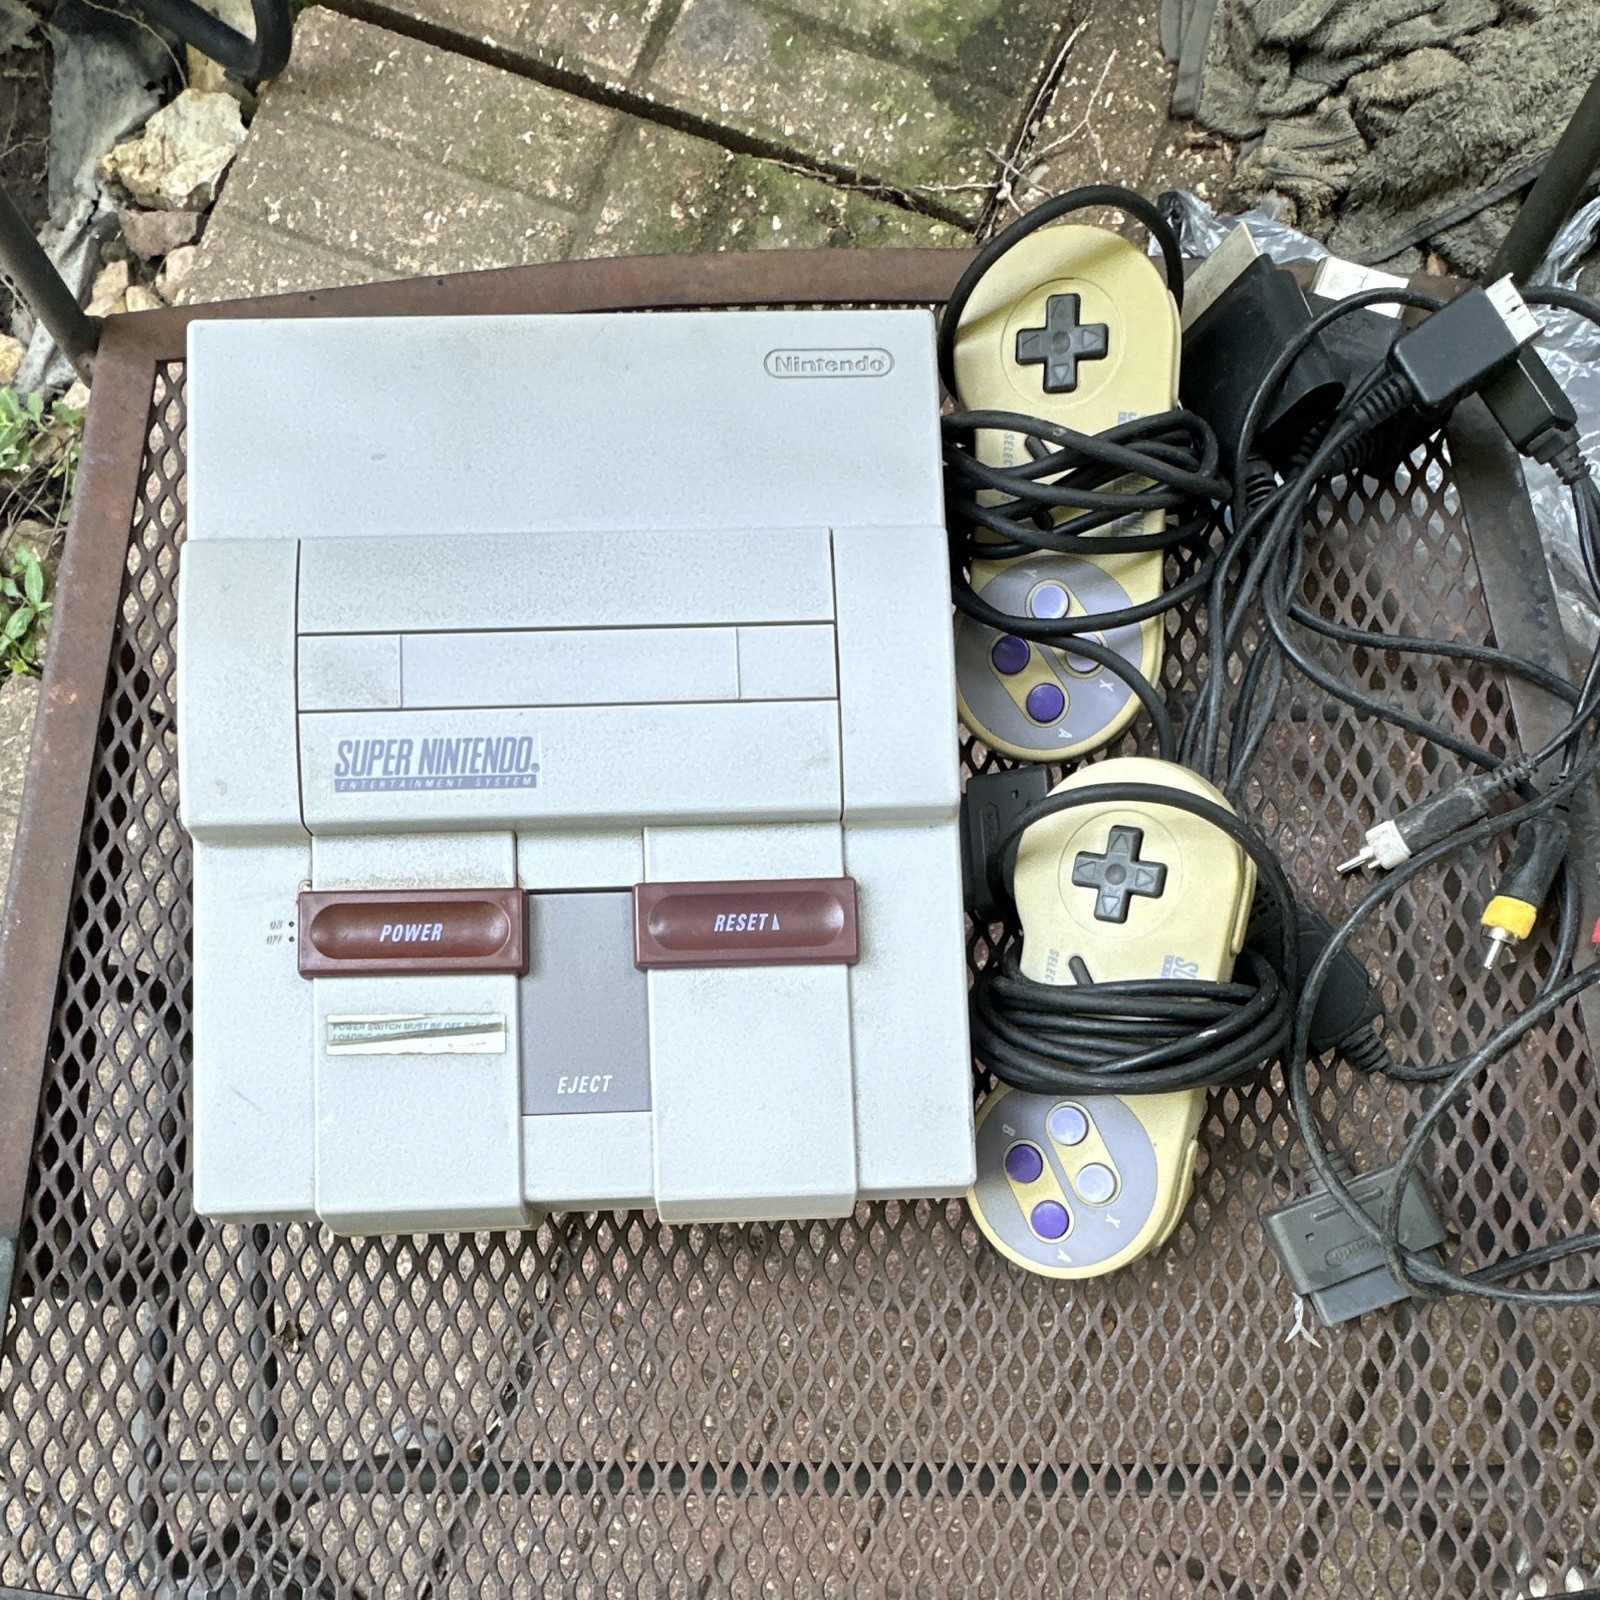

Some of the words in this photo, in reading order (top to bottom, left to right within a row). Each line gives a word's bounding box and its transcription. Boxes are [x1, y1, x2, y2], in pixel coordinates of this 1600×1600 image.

[774, 355, 885, 373] Nintendo
[1003, 431, 1014, 466] SELEC
[1099, 679, 1114, 692] X
[1058, 727, 1073, 739] A
[334, 738, 415, 777] SUPER
[338, 778, 464, 791] ENTERTAINMENT
[474, 776, 532, 788] SYSTEM
[714, 912, 769, 932] RESET
[379, 923, 443, 942] POWER
[1044, 948, 1059, 982] SELEC
[367, 1023, 402, 1031] SWITCH
[403, 1022, 427, 1031] MUST
[557, 1074, 614, 1095] EJECT
